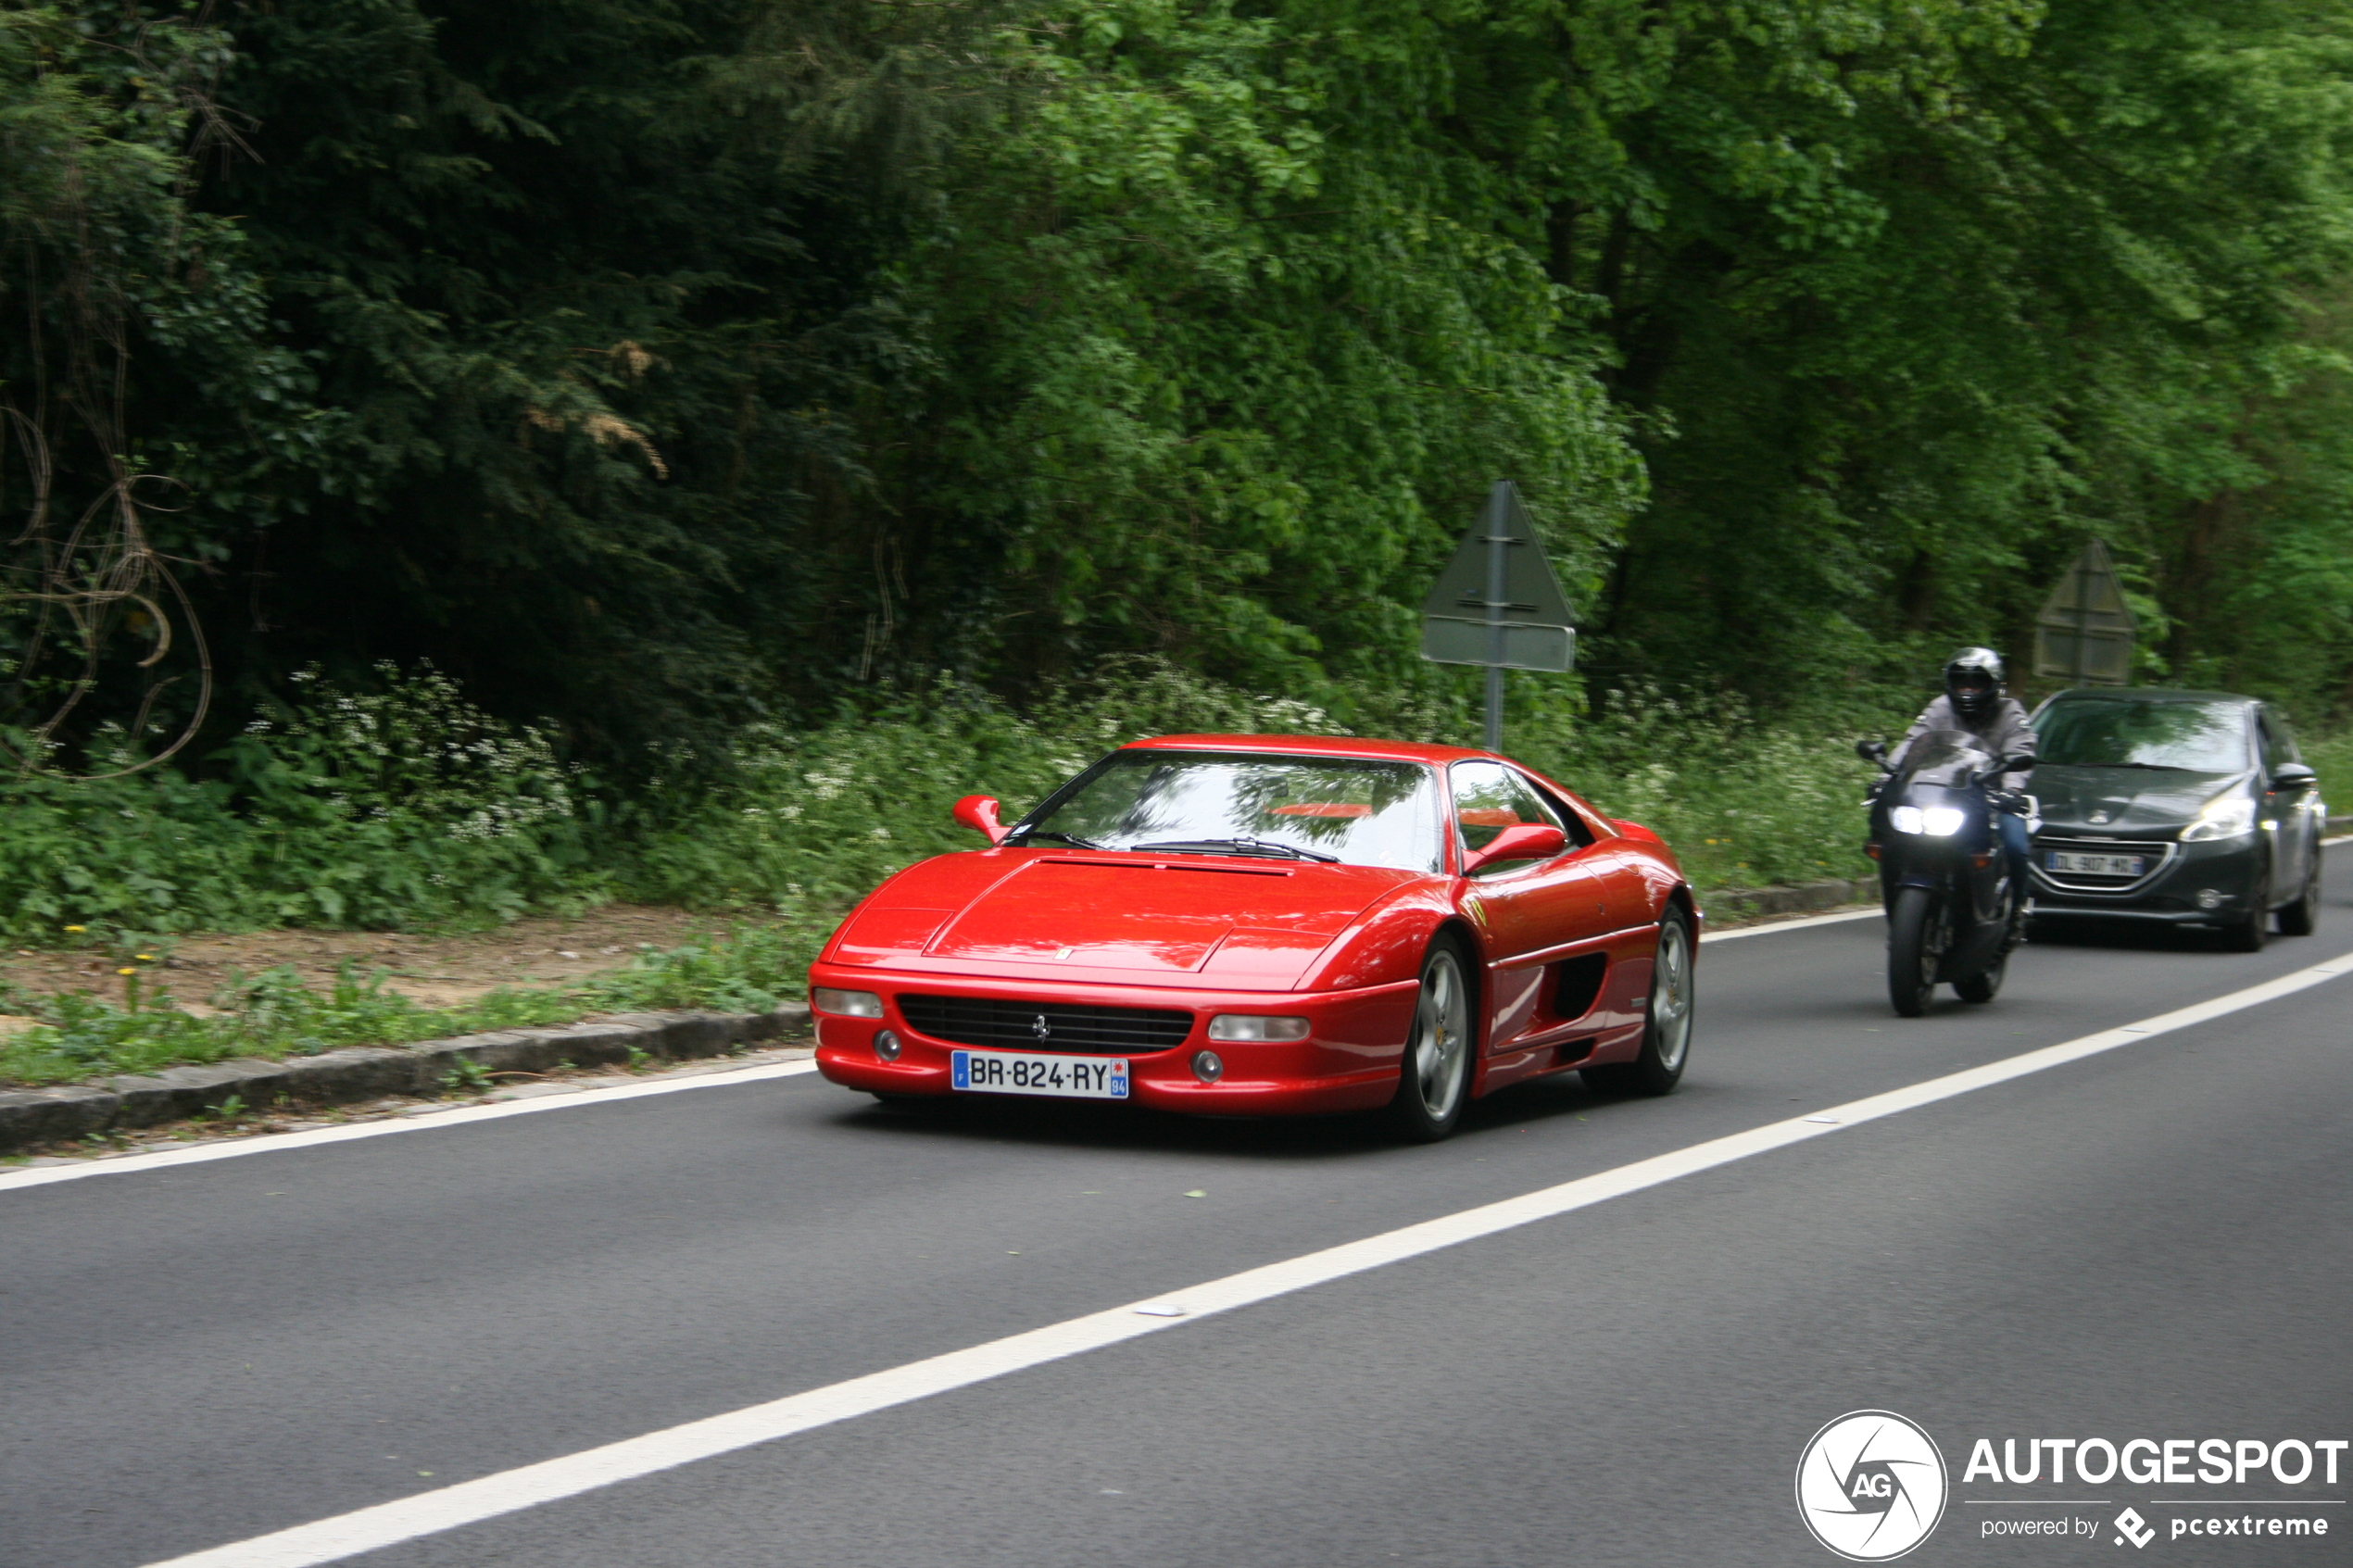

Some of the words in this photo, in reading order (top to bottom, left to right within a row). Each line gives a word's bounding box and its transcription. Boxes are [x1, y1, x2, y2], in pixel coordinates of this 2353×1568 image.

[958, 1073, 964, 1083] F
[971, 1058, 1107, 1091] BR-824-RY
[1112, 1079, 1126, 1094] 94
